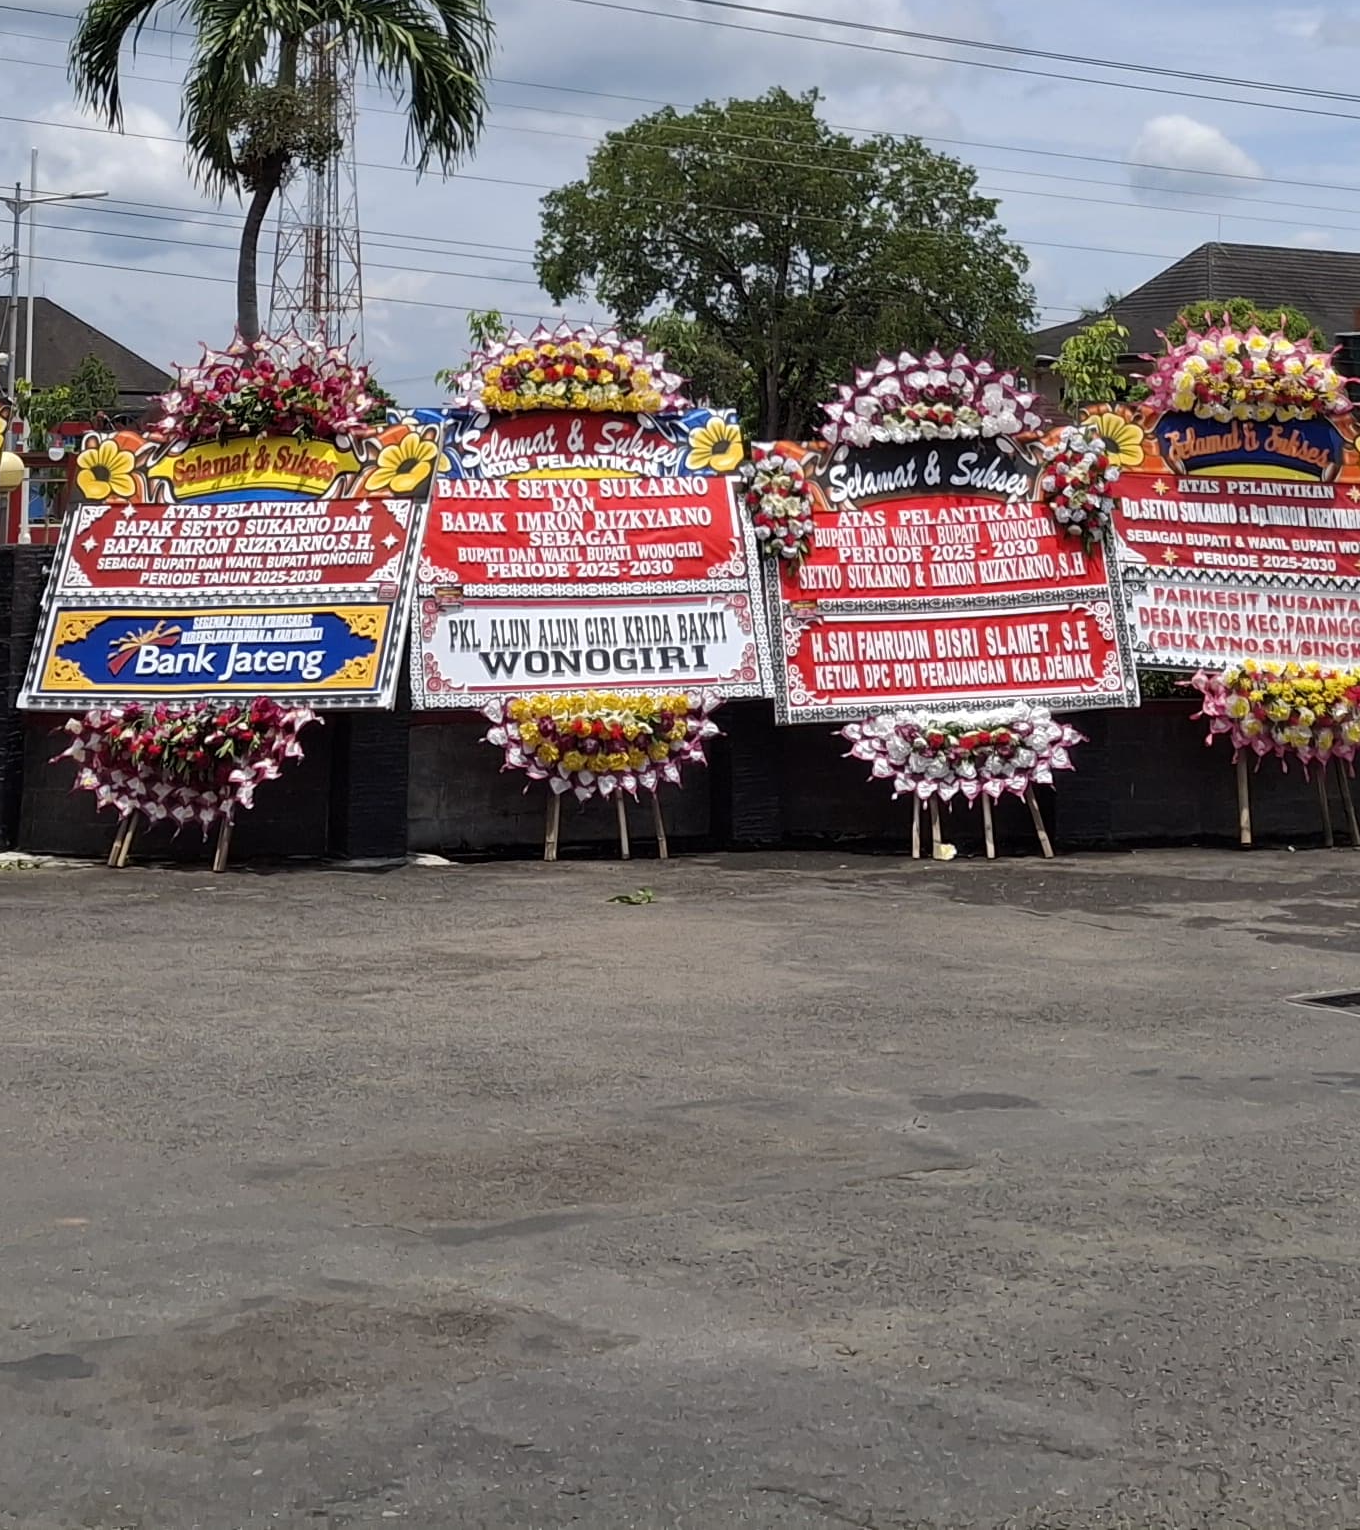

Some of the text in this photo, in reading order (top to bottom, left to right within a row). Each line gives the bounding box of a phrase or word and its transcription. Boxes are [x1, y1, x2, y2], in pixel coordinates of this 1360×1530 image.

[462, 422, 680, 467] Selamat Sukses
[1165, 424, 1241, 460] Selamat
[172, 444, 337, 487] Selamat Sukses
[488, 456, 659, 476] ATAS PELANTIKAN
[830, 452, 1029, 502] Selamat Sukses
[438, 478, 709, 498] BAPAK SETYO SUKARNO
[1178, 479, 1334, 498] ATAS PELANTIKAN
[163, 501, 327, 518] ATAS PELANTIKAN
[552, 497, 595, 511] DAN
[838, 503, 1033, 527] ATAS PELANTIKAN
[114, 516, 372, 537] BAPAK SETYO SUKARNO DAN
[441, 507, 712, 532] BAPAK IMRON RIZKYARNO
[103, 539, 162, 554] BAPAK
[170, 538, 230, 554] IMRON
[529, 530, 626, 546] SEBAGAI
[815, 524, 980, 547] BUPATI DAN WAKIL BUPATI
[1127, 529, 1182, 544] SEBAGAI
[1186, 534, 1231, 548] BUPATI
[1247, 536, 1289, 551] WAKIL
[1292, 540, 1336, 553] BUPATI
[96, 552, 373, 570] SEBAGAI BUPATI DAN WAKIL BUPATI WONOGIRI
[458, 541, 703, 562] BUPATI DAN WAKIL BUPATI WONOGIRI
[839, 539, 1038, 563] PERIODE 2025 2030
[1194, 552, 1336, 571] PERIODE 2025-2030
[140, 570, 321, 585] PERIODE TAHUN 2025-2030
[487, 563, 569, 577] PERIODE
[799, 568, 842, 589] SETYO
[848, 565, 911, 589] SUKARNO
[931, 563, 976, 586] IMRON
[1154, 588, 1260, 606] PARIKESIT
[449, 612, 728, 648] PKL ALUN ALUN GIRI KRIDA BAKTI
[1140, 607, 1183, 628] DESA
[1187, 612, 1240, 631] KETOS
[858, 624, 1050, 661] FAHRUDIN BISRI SLAMET
[135, 644, 326, 680] Bank Jateng
[479, 645, 709, 676] WONOGIRI
[815, 666, 859, 690] KETUA
[863, 665, 890, 688] DPC
[895, 664, 916, 687] PDI
[920, 660, 1006, 686] PERJUANGAN
